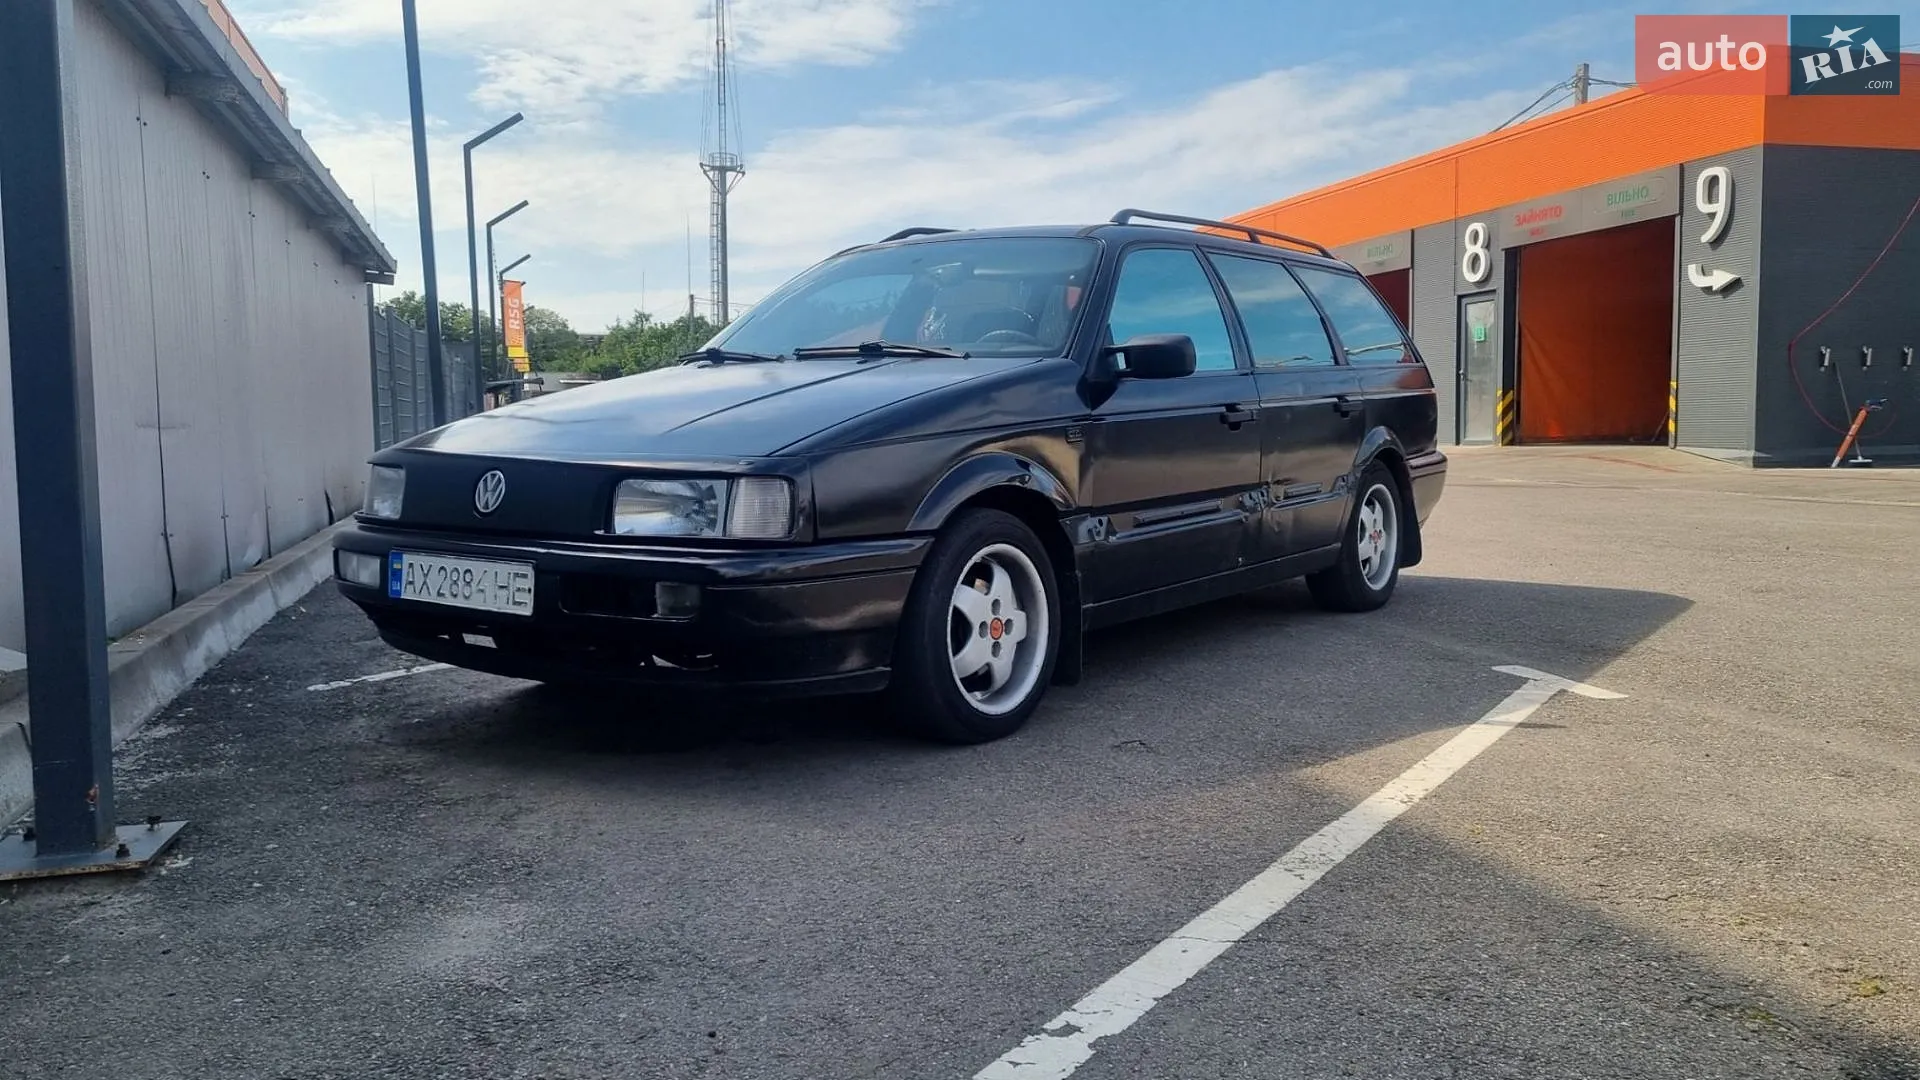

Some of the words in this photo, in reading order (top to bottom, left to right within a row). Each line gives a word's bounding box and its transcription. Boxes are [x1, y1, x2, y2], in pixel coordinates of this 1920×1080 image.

[1607, 185, 1649, 206] ВІЛЬНО
[1696, 166, 1732, 243] 9
[1462, 222, 1491, 283] 8
